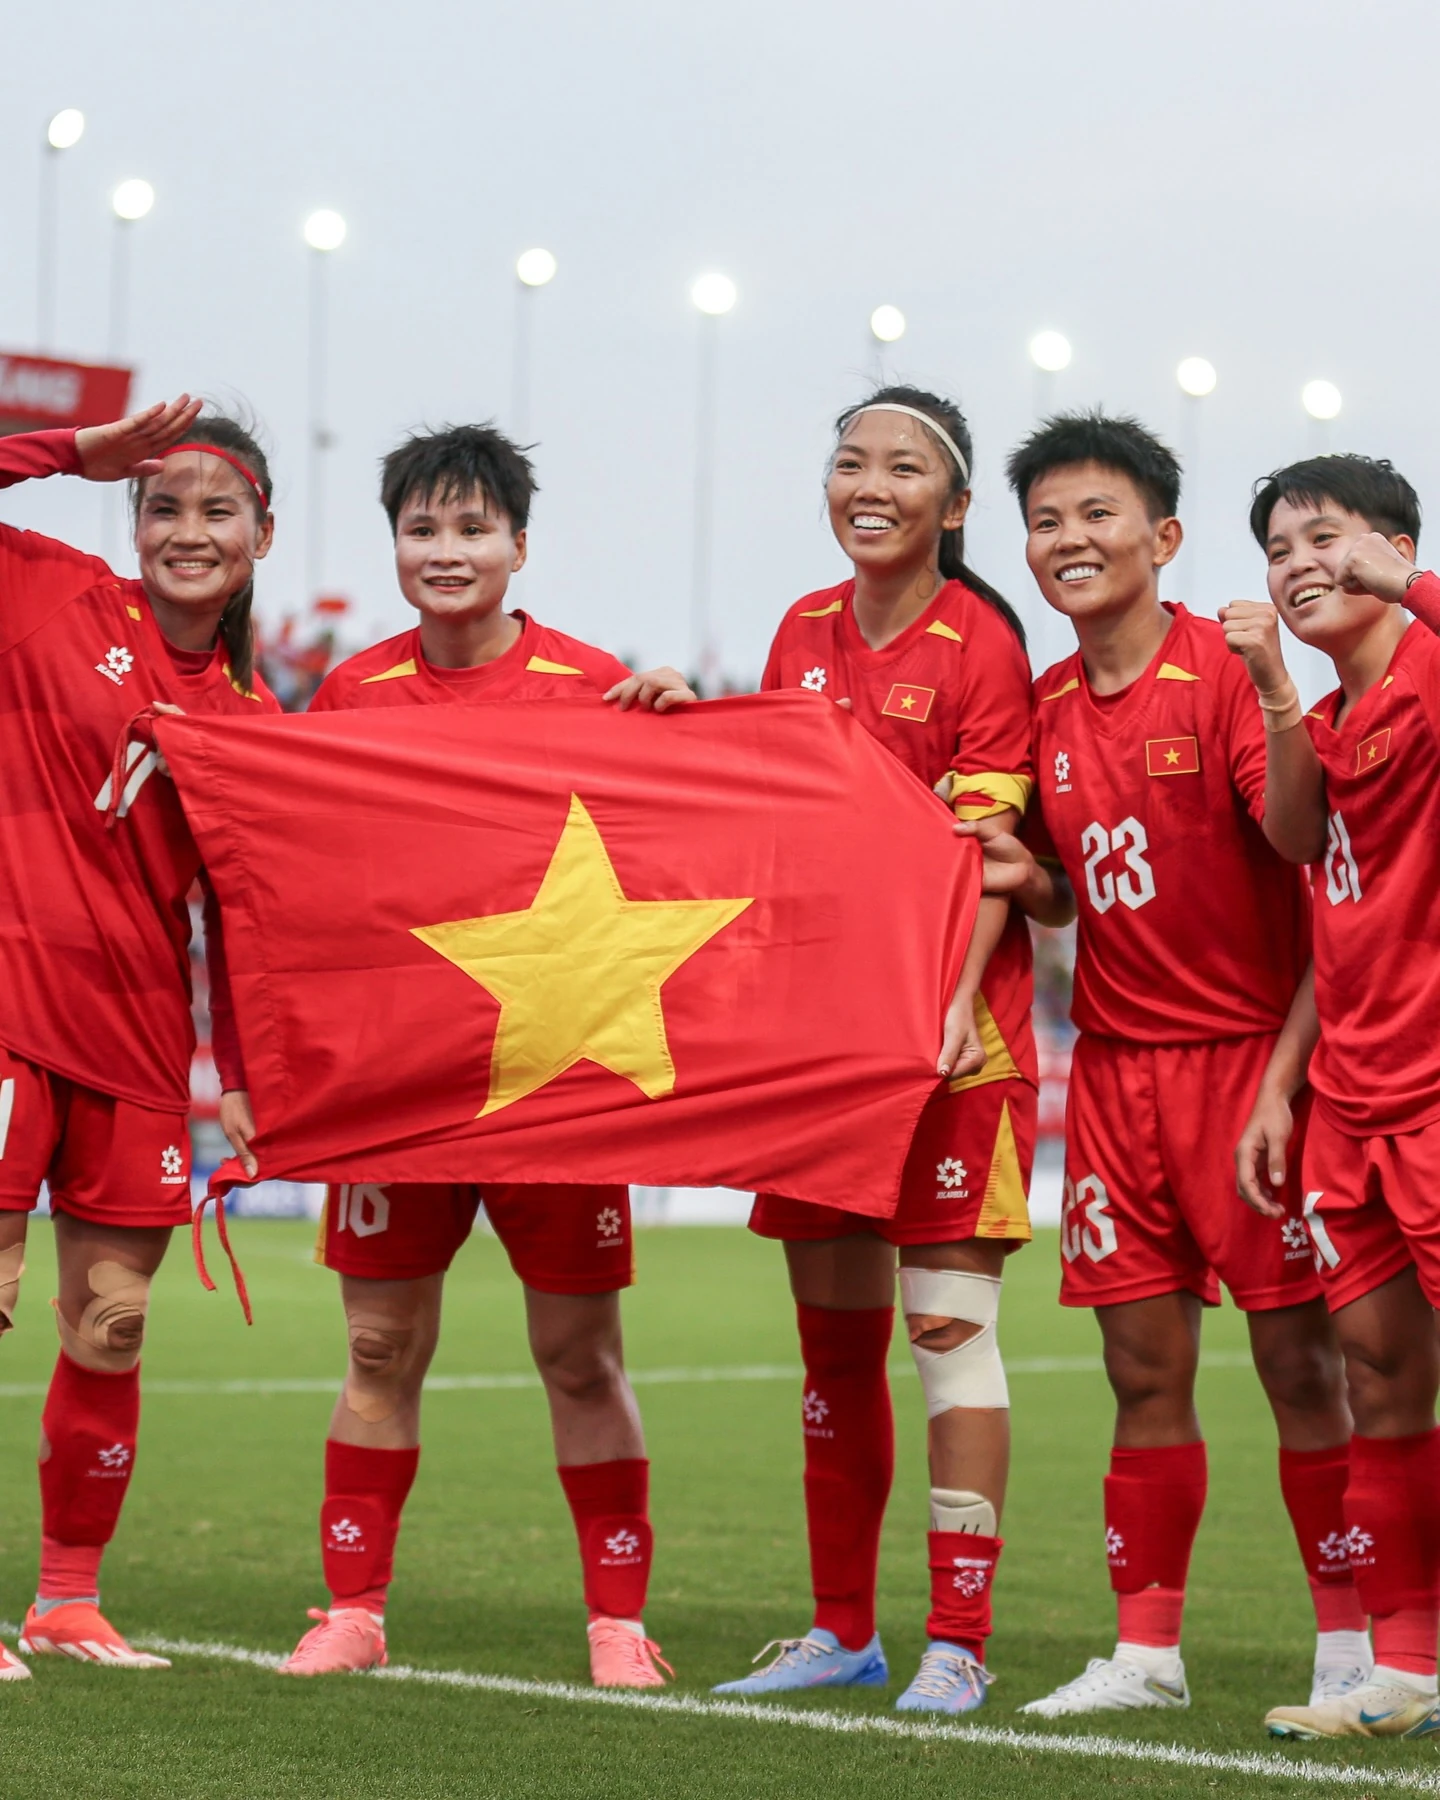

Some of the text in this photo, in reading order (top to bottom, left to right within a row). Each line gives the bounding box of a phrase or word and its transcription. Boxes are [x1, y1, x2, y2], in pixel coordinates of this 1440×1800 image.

[1080, 815, 1157, 915] 23
[1324, 809, 1363, 907] 21
[1061, 1172, 1118, 1264] 23
[1302, 1191, 1341, 1275] 1
